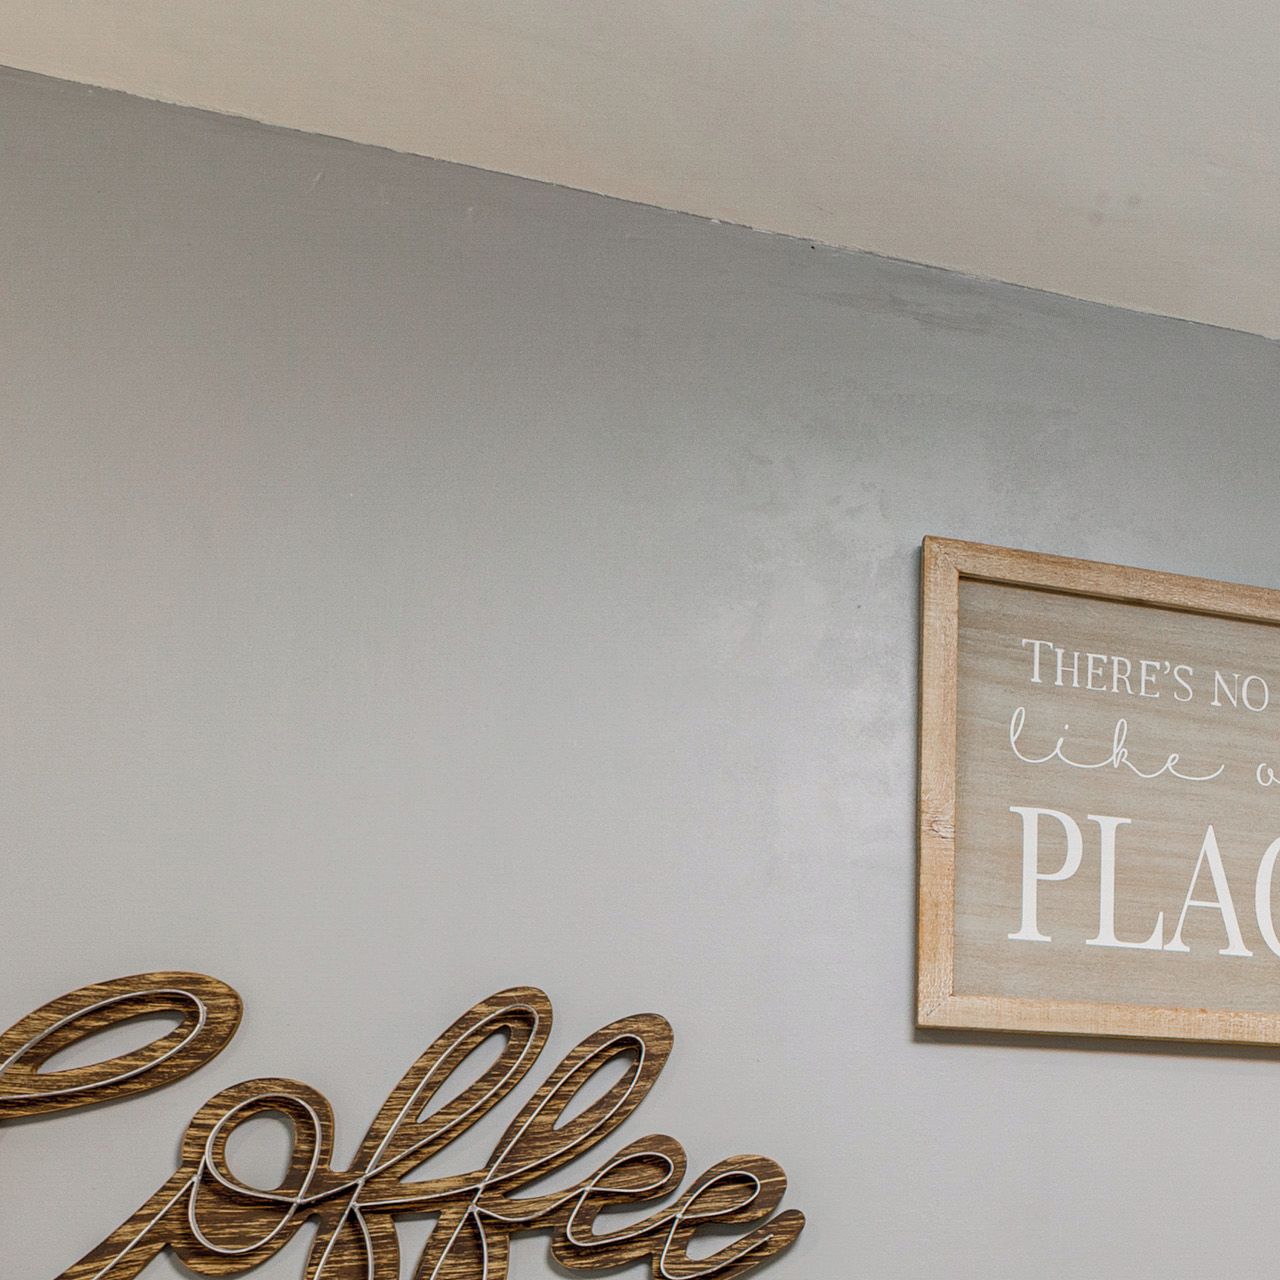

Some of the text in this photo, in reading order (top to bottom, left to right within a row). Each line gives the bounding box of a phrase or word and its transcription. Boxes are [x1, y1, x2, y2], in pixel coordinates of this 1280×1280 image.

[1021, 637, 1194, 703] THERE'S
[1210, 669, 1270, 713] NO
[1009, 705, 1226, 782] like
